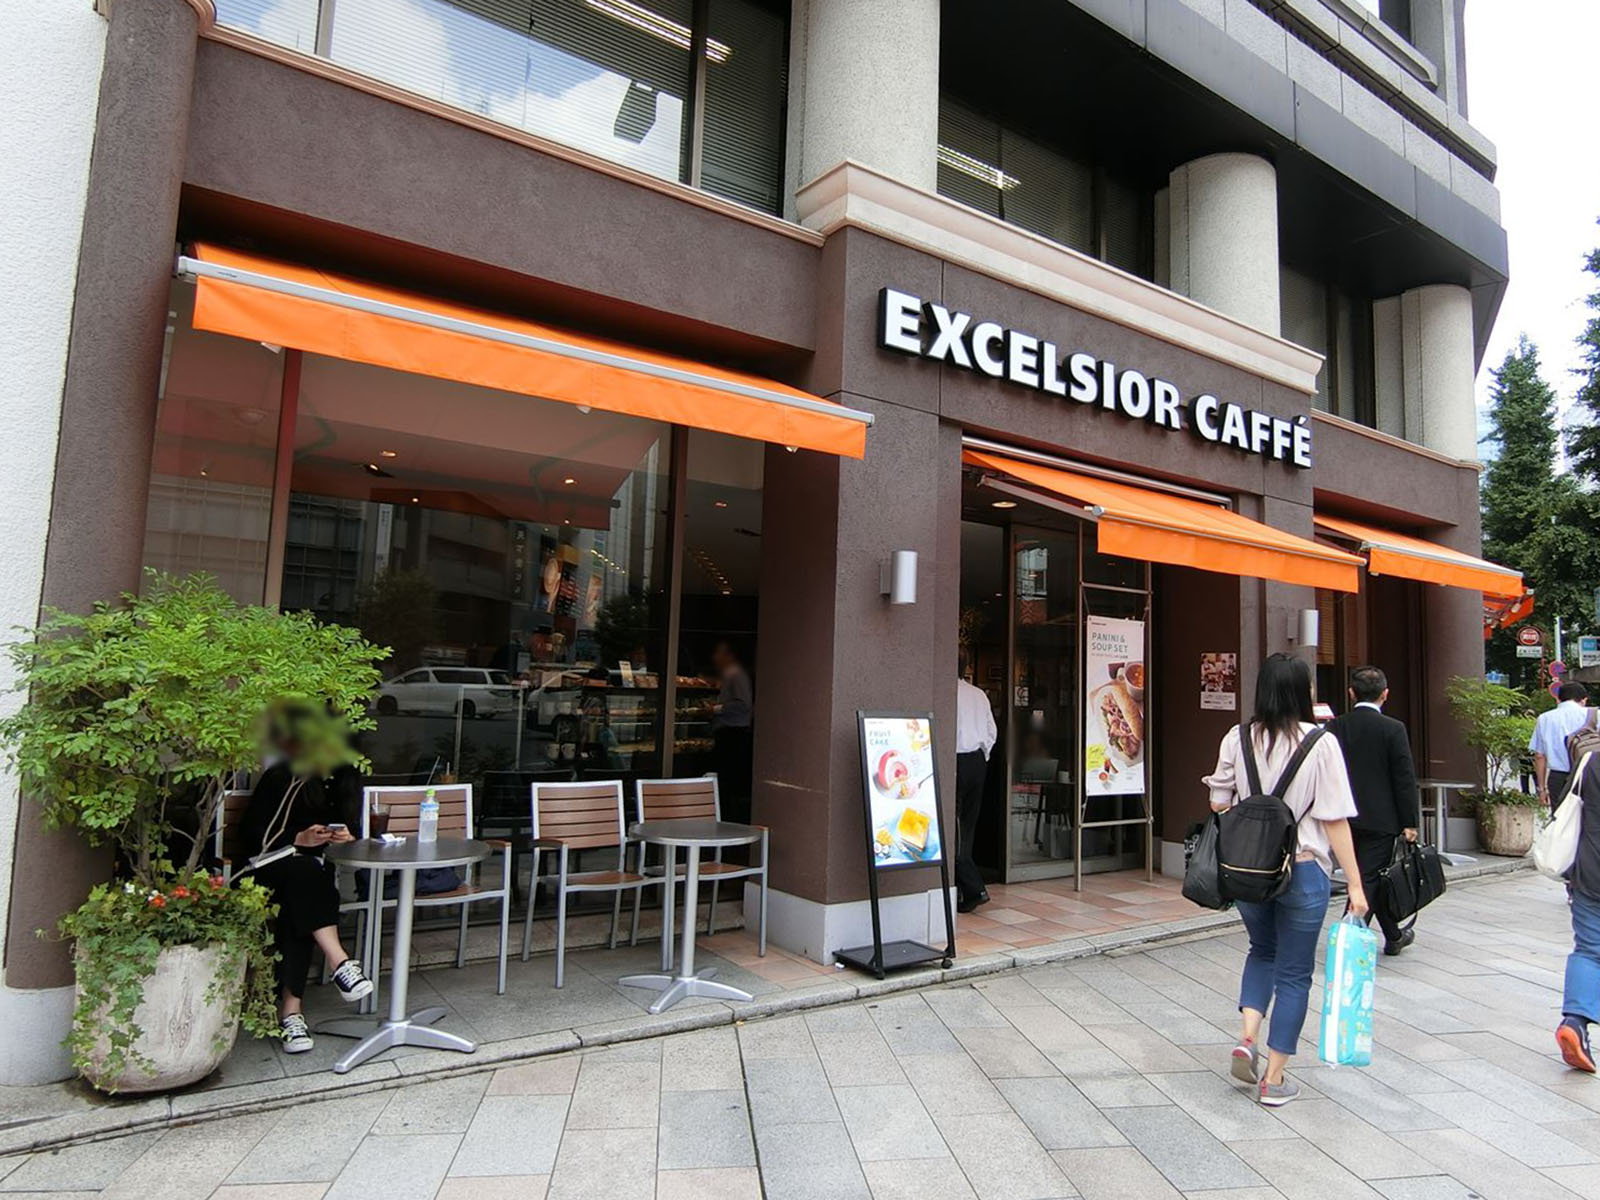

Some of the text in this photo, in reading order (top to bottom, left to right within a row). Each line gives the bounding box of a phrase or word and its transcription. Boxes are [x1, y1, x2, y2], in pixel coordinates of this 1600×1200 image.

[881, 287, 1312, 469] EXCELSIOR CAFFÉ
[1091, 642, 1128, 653] SOUP SET
